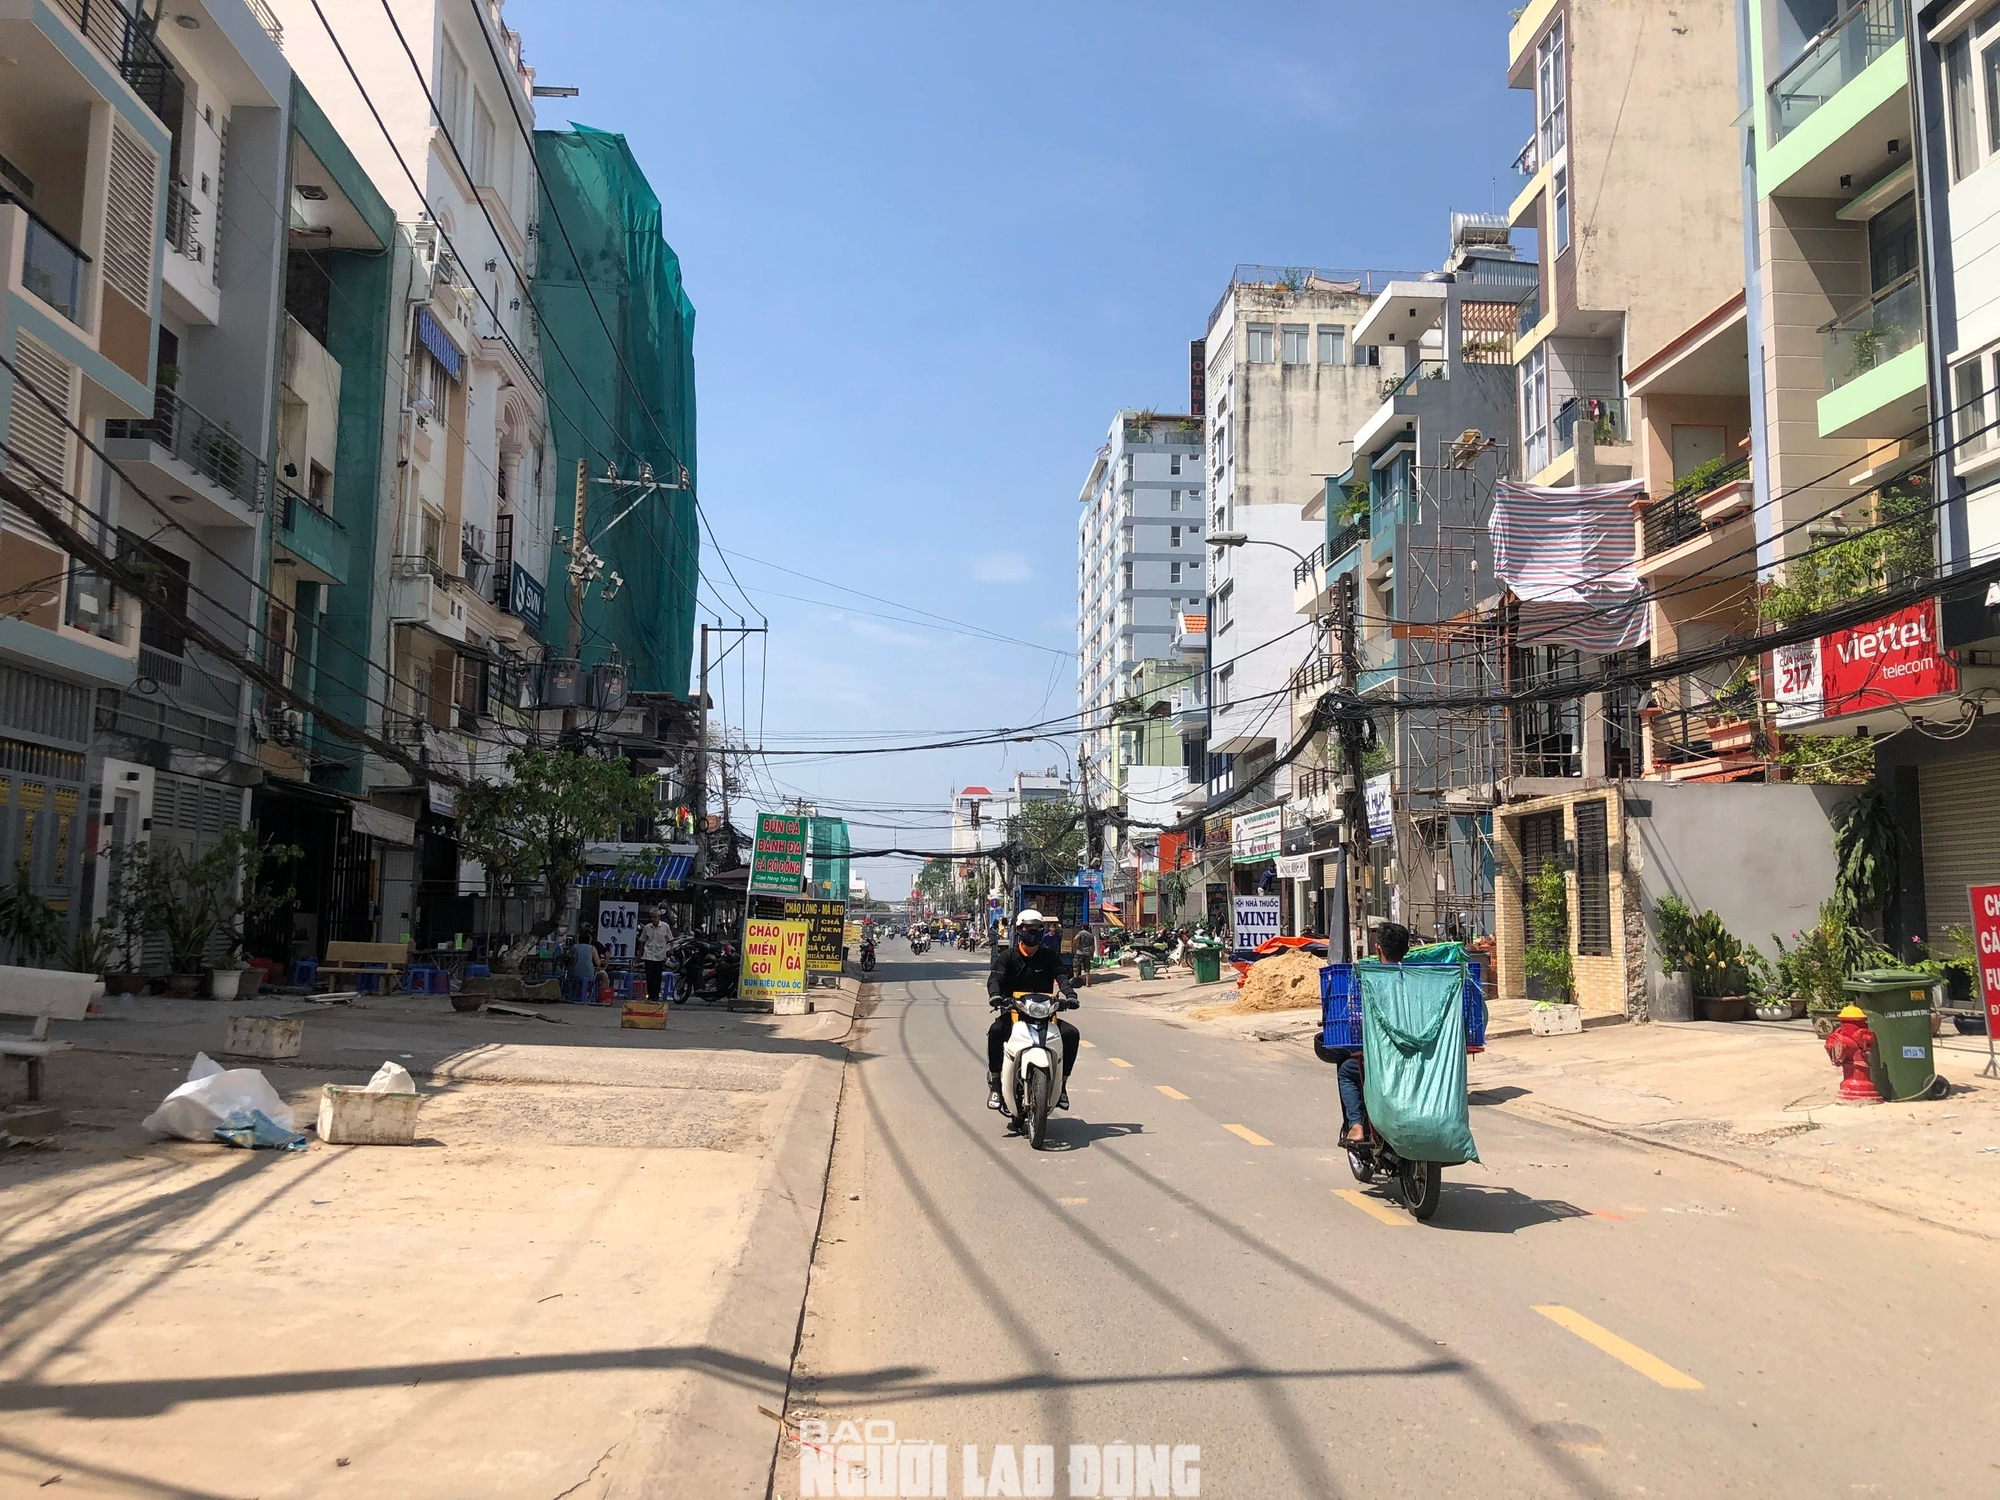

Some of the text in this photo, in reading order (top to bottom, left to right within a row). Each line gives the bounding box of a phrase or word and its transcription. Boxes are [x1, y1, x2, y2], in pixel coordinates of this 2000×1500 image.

[1192, 346, 1204, 414] HOTEL
[526, 586, 541, 616] SVN
[1836, 614, 1932, 664] viettel
[1882, 657, 1934, 680] telecom
[1782, 663, 1812, 693] 217
[763, 816, 800, 834] BÚN CÁ
[757, 836, 802, 855] BÁNH ĐA
[785, 901, 801, 913] CHÁO
[802, 901, 818, 914] LÒNG
[832, 905, 844, 916] HEO
[1245, 897, 1279, 908] NHÀ THUỐC
[600, 905, 637, 935] GIẶT
[1236, 911, 1278, 926] MINH
[748, 923, 780, 937] CHÁO
[748, 939, 777, 955] MIẾN
[787, 932, 806, 952] VỊT
[751, 958, 771, 974] GỎI
[786, 952, 802, 970] GÀ
[777, 980, 790, 988] CUA
